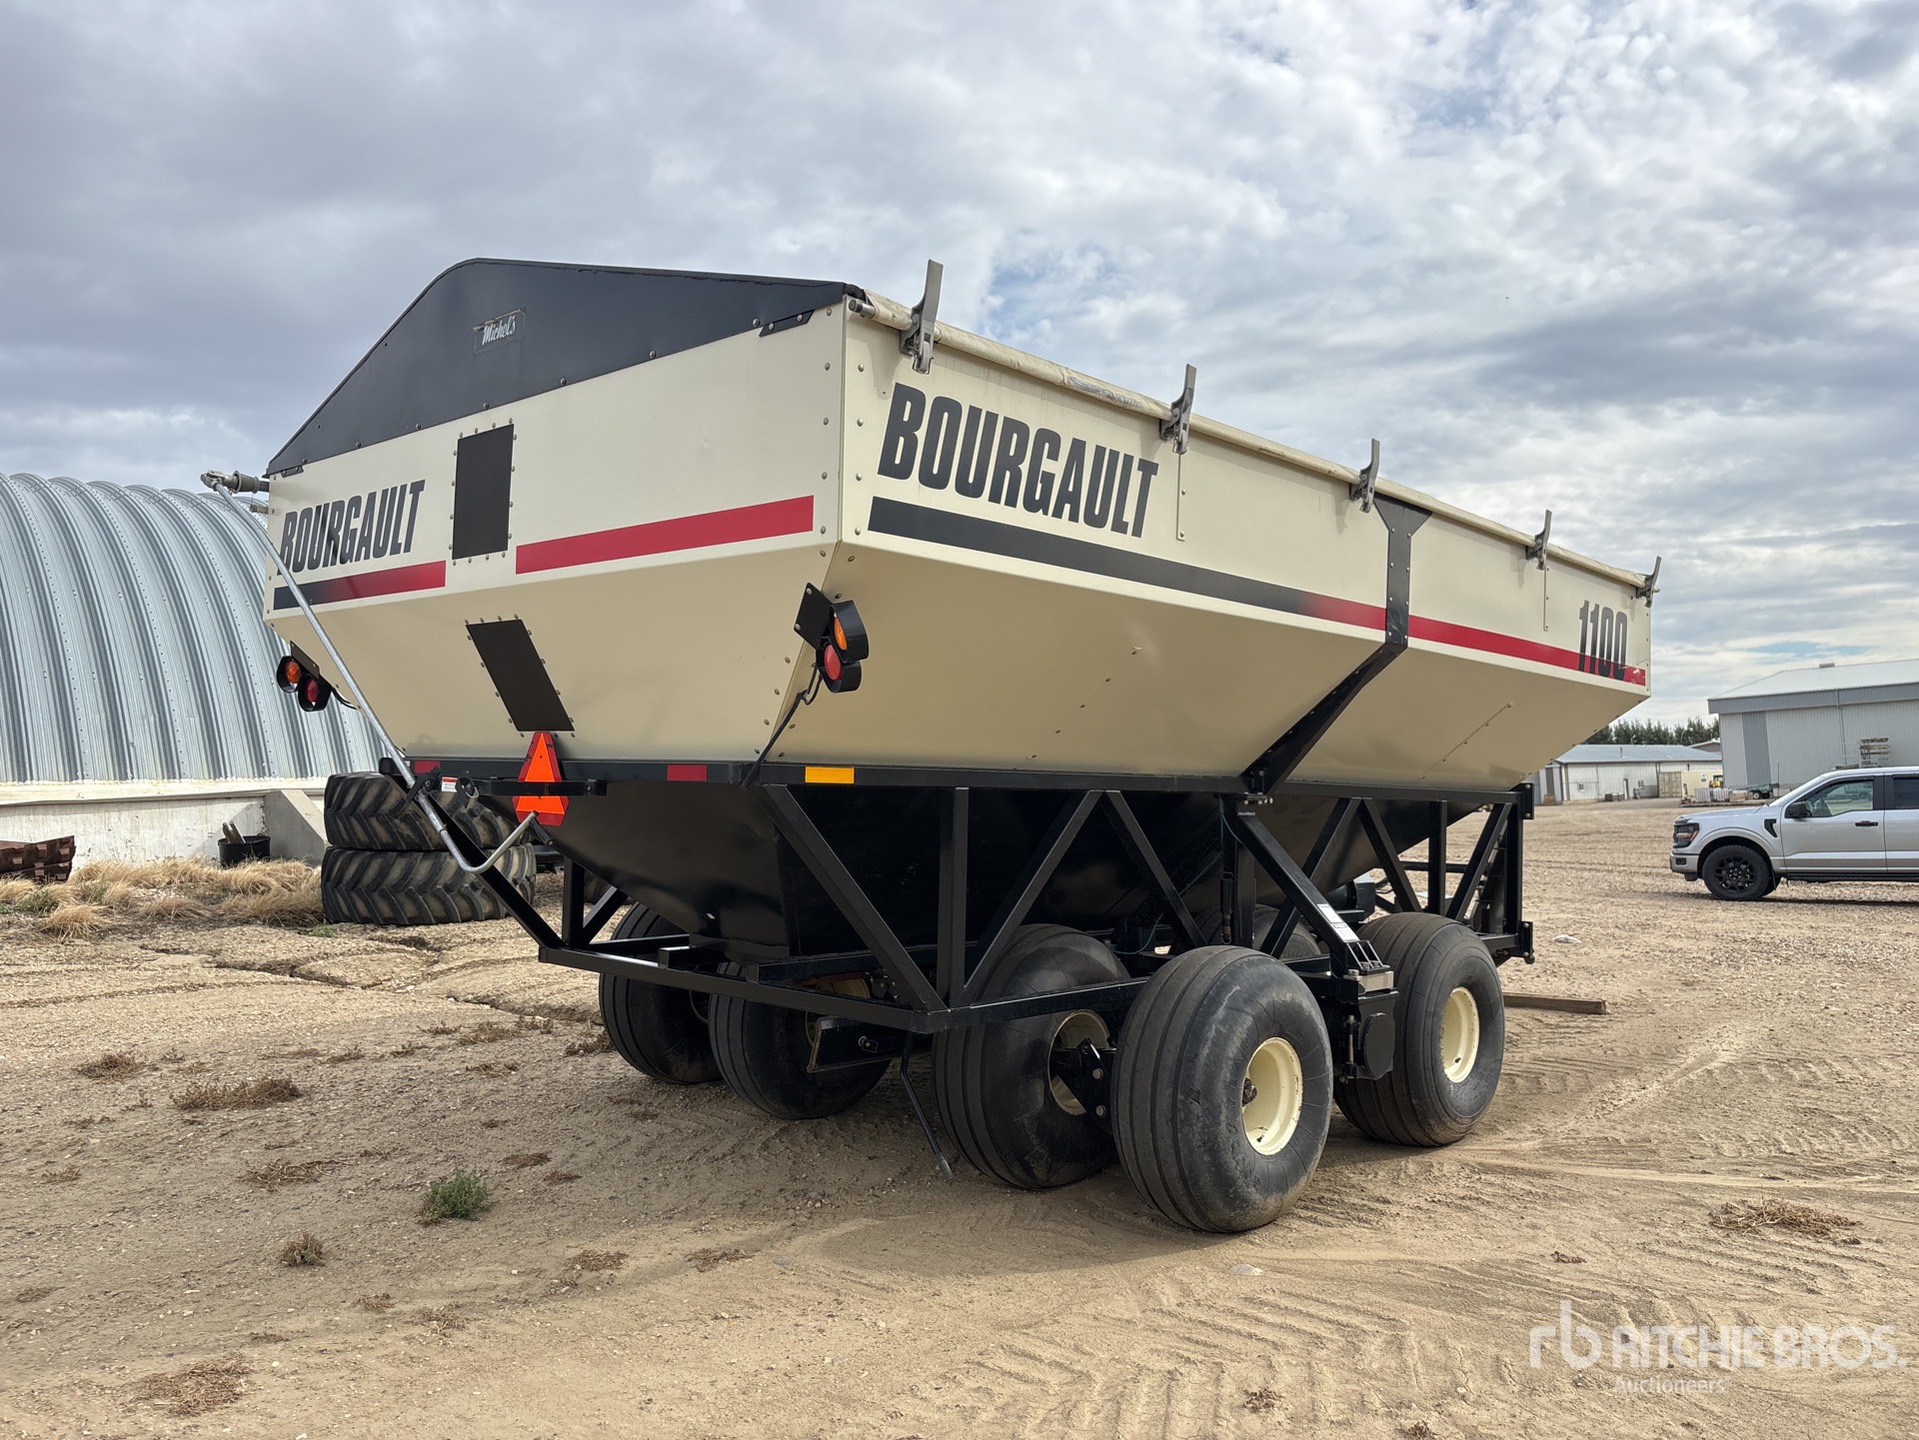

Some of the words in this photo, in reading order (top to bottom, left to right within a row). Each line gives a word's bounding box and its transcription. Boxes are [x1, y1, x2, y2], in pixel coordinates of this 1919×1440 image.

[877, 382, 1160, 539] BOURGAULT
[277, 479, 426, 576] BOURGAULT
[1578, 600, 1628, 681] 1100
